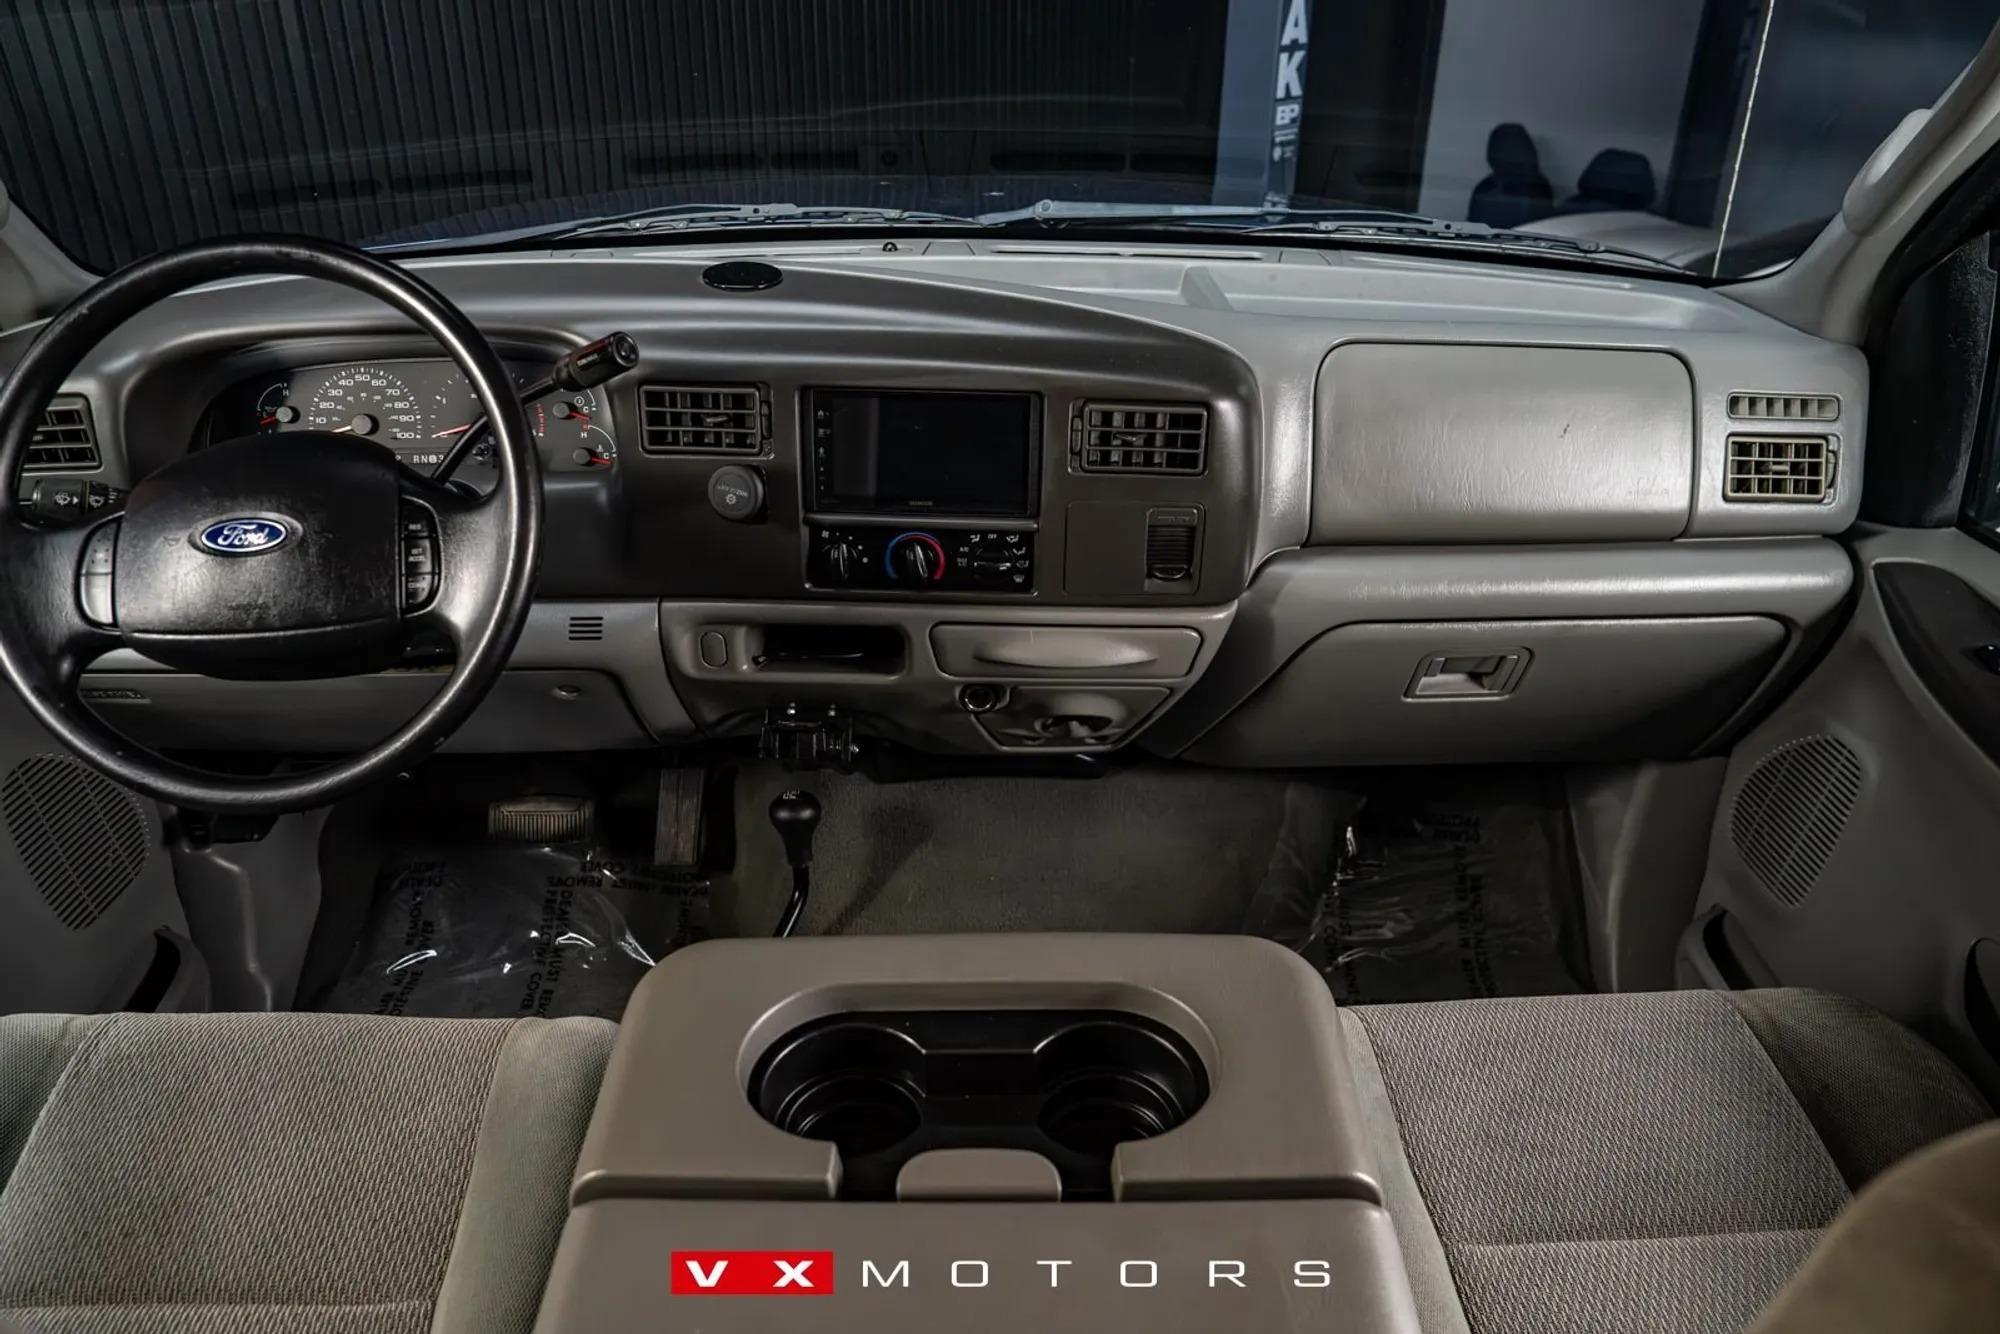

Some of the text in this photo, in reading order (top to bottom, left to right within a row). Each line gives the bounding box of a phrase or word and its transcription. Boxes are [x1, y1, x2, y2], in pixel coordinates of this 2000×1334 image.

[354, 374, 370, 382] 50
[338, 379, 354, 387] 40
[371, 379, 387, 387] 60
[327, 389, 343, 397] 30
[385, 389, 400, 397] 70
[319, 402, 335, 410] 20
[394, 401, 410, 409] 80
[217, 523, 270, 547] Ford
[520, 972, 542, 1010] COVER
